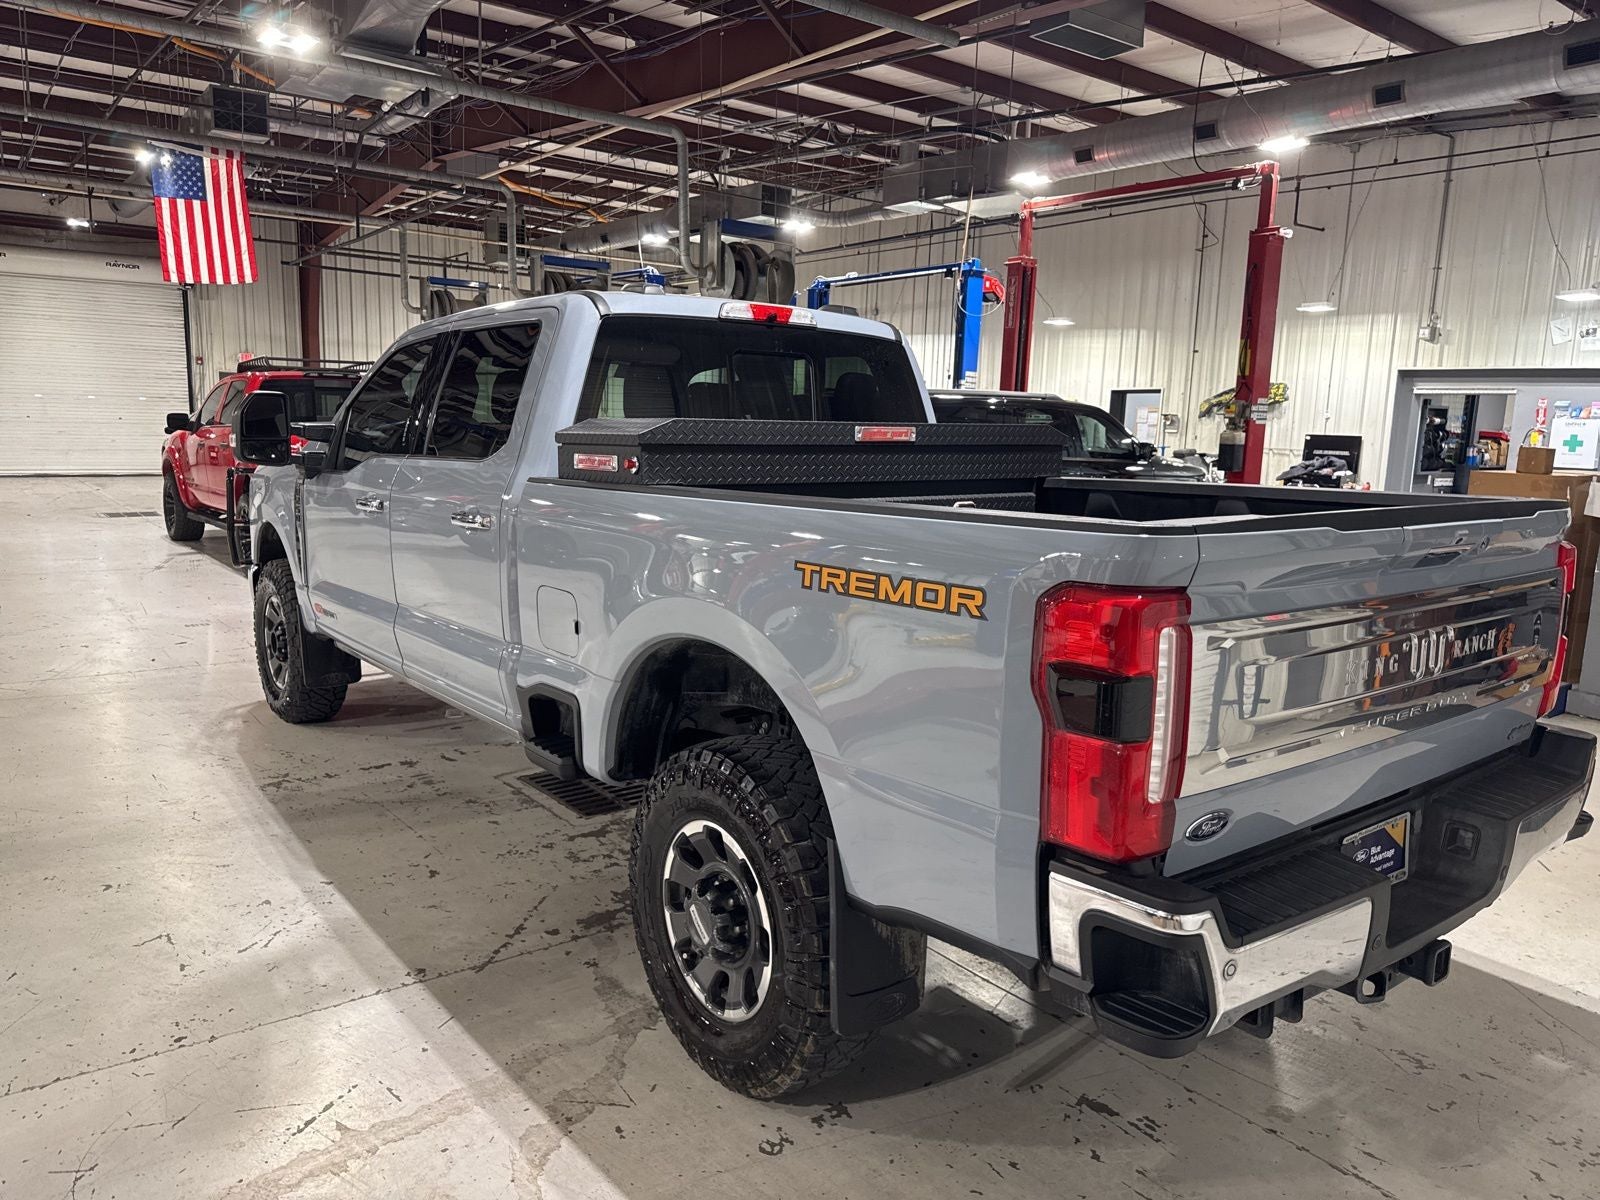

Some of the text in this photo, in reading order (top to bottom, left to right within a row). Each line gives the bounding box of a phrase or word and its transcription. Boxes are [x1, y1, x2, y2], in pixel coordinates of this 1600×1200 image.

[105, 260, 140, 270] RAYNOR
[794, 560, 989, 621] TREMOR
[1346, 653, 1399, 684] KING
[1453, 628, 1497, 658] RANCH
[1369, 848, 1395, 864] Advantage
[1370, 845, 1382, 856] Blue
